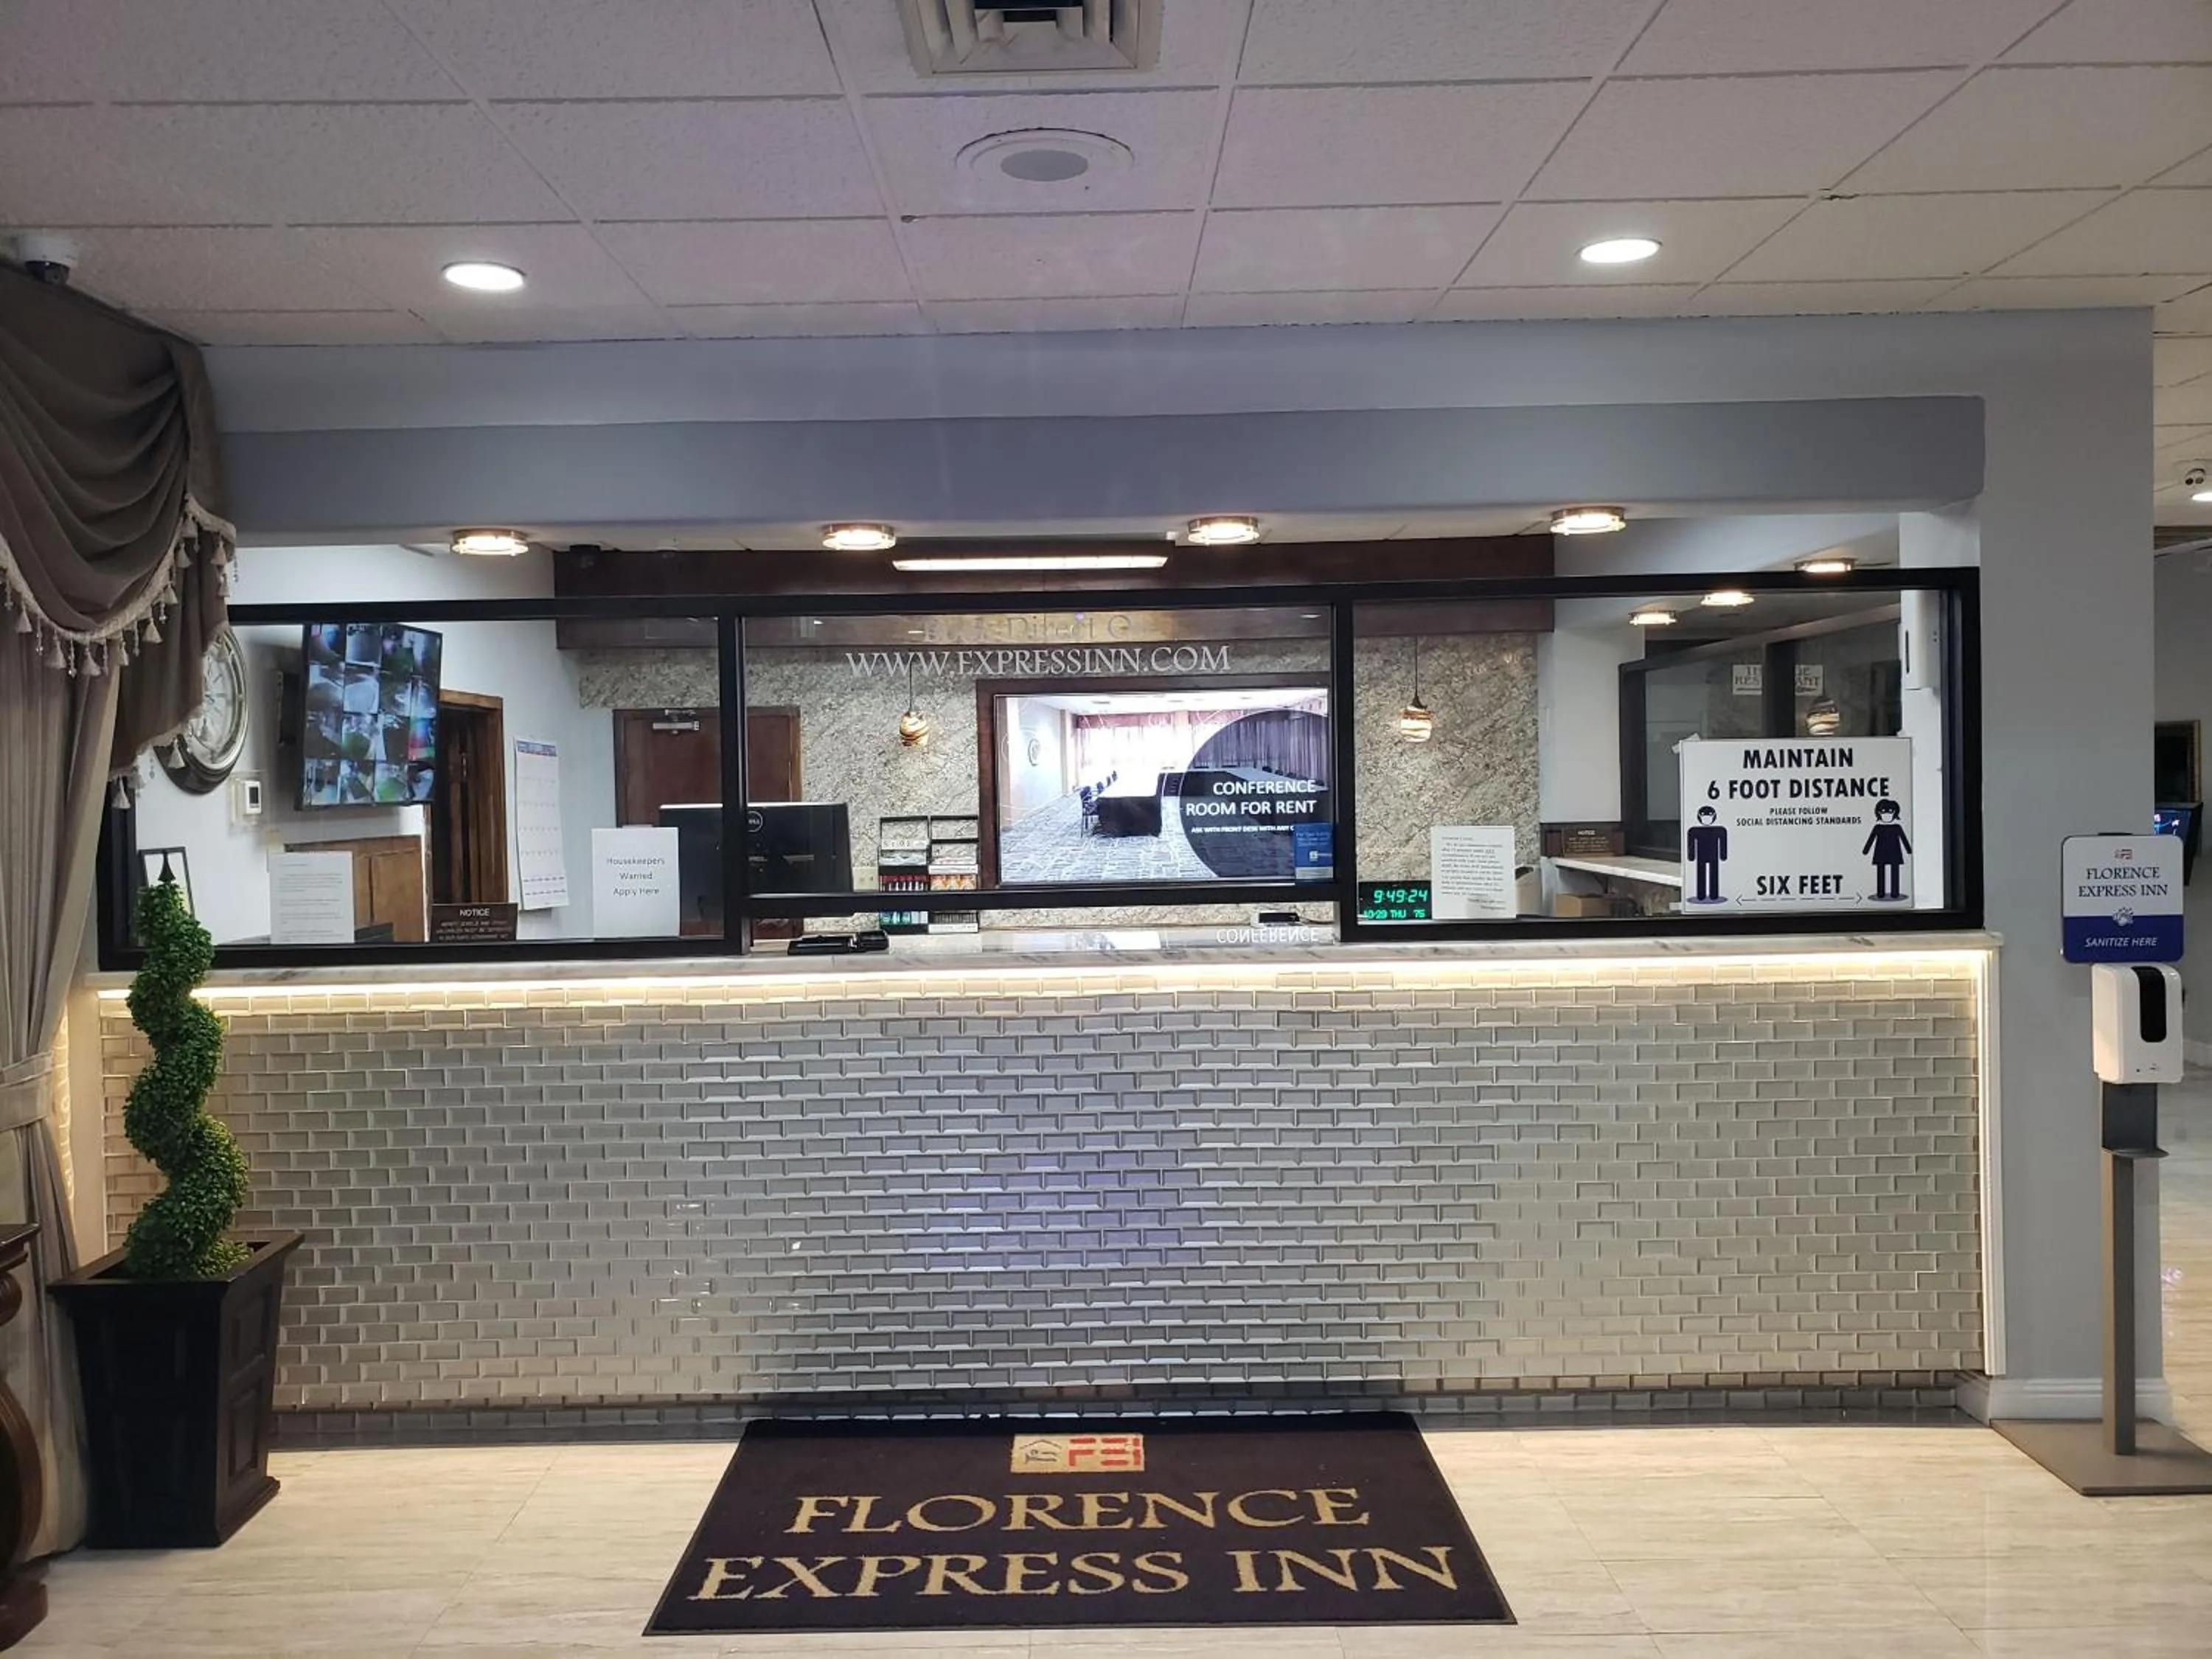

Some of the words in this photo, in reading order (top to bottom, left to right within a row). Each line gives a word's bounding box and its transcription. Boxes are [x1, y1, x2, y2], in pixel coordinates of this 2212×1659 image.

[845, 645, 1232, 678] WWW.EXPRESSINN.COM
[1742, 748, 1854, 769] MAINTAIN
[1213, 779, 1317, 796] CONFERENCE
[1707, 780, 1720, 800] 6
[1729, 779, 1781, 799] FOOT
[1790, 777, 1890, 799] DISTANCE
[1186, 801, 1236, 816] ROOM
[1240, 801, 1272, 815] FOR
[1276, 800, 1318, 814] RENT
[1770, 807, 1795, 815] PLEASE
[1798, 807, 1828, 815] FOLLOW
[1736, 818, 1764, 827] SOCIAL
[1766, 817, 1814, 826] DISTANCING
[1816, 816, 1862, 825] STANDARDS
[607, 855, 665, 866] Housekeepers
[619, 871, 653, 880] Wanted
[2086, 866, 2160, 880] FLORENCE
[1756, 875, 1791, 895] SIX
[1798, 874, 1843, 894] FEET
[2078, 884, 2137, 897] EXPRESS
[2140, 884, 2168, 897] INN
[613, 887, 638, 897] Apply
[639, 887, 660, 895] Here
[1374, 889, 1428, 903] 9:49:24
[459, 908, 490, 917] NOTICE
[1390, 909, 1406, 919] THU
[2084, 937, 2129, 947] SANITIZE
[2131, 937, 2158, 946] HERE
[782, 1485, 1370, 1536] FLORENCE
[686, 1551, 1190, 1602] EXPRESS
[1233, 1545, 1459, 1593] INN
